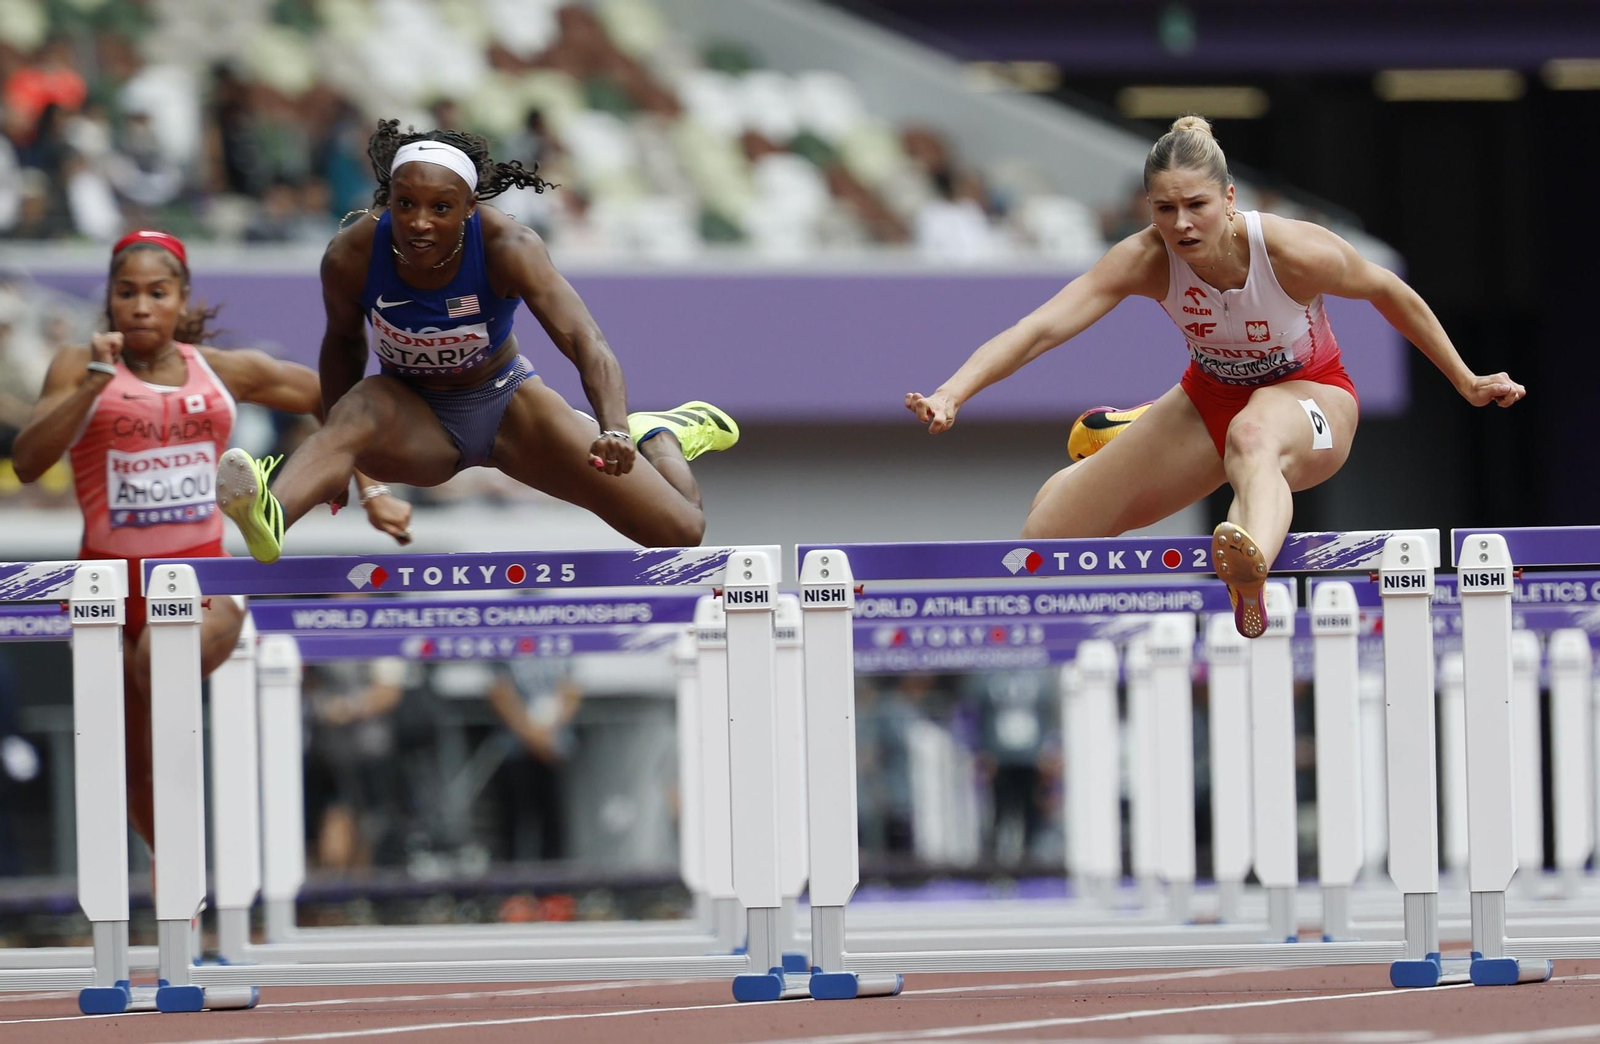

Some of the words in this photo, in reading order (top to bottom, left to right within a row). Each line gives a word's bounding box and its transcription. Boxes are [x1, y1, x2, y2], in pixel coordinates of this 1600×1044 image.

[1182, 306, 1212, 316] ORLEN
[374, 316, 483, 347] HONDA
[1200, 346, 1286, 359] ONDA
[114, 415, 213, 443] CANADA
[112, 452, 210, 474] HONDA
[116, 474, 210, 503] AHOLOU
[1053, 549, 1182, 571] TOKYO
[1192, 549, 1208, 568] 2
[398, 563, 526, 586] TOKYO
[536, 563, 576, 583] 25
[1384, 574, 1425, 588] NISHI
[1463, 572, 1505, 586] NISHI
[727, 590, 768, 604] NISHI
[804, 588, 845, 603] NISHI
[922, 595, 1031, 617] ATHLETICS
[1034, 591, 1204, 614] CHAMPIONSHIPS
[74, 604, 115, 618] NISHI
[151, 603, 193, 617] NISHI
[293, 609, 368, 629] WORLD
[371, 606, 481, 628] ATHLETICS
[483, 603, 652, 626] CHAMPIONSHIPS
